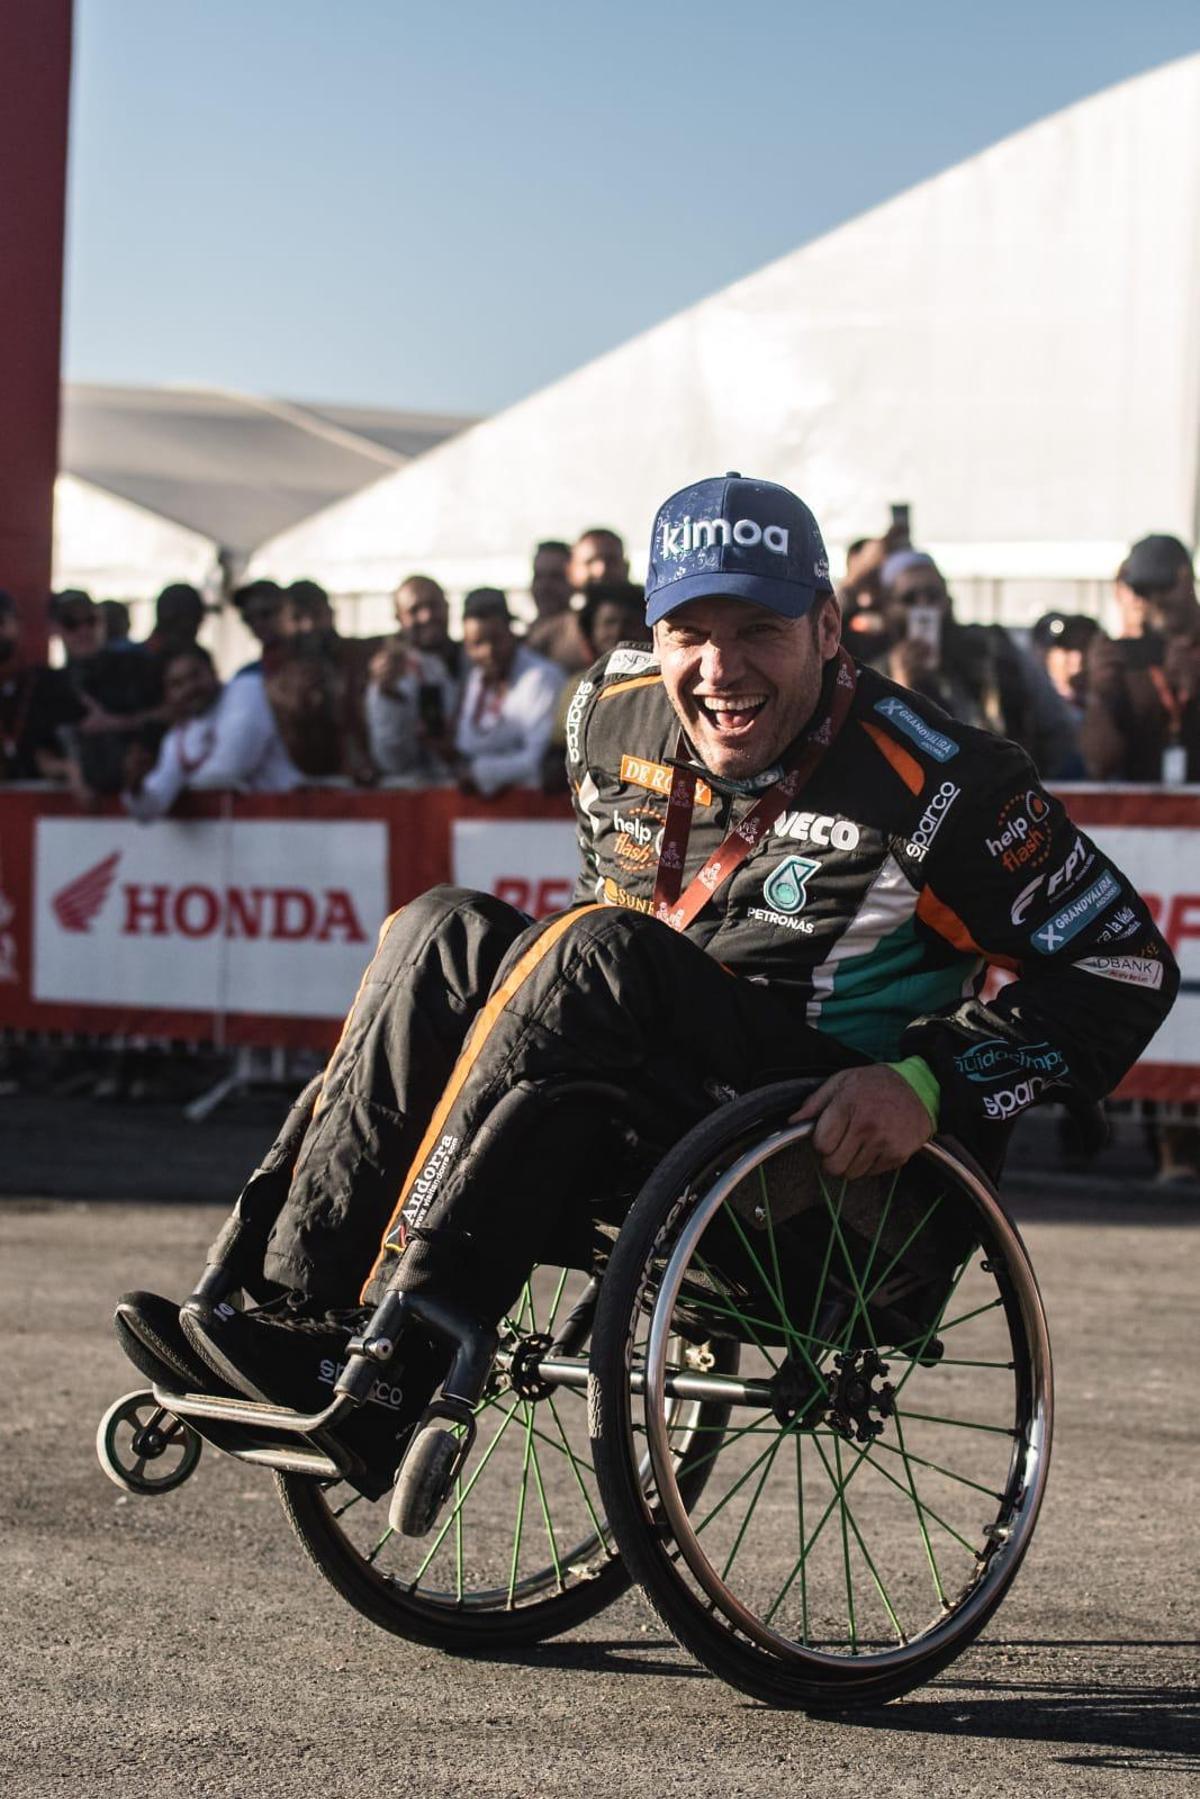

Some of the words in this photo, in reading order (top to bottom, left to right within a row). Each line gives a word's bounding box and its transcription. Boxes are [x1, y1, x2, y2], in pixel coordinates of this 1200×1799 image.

[662, 515, 789, 560] kimoa
[566, 680, 593, 763] sparco
[898, 709, 952, 754] GRANDVALIRA
[613, 809, 652, 846] help
[766, 810, 860, 851] VECO
[906, 781, 961, 862] sparco
[985, 817, 1028, 857] help
[614, 832, 653, 863] flash
[1002, 829, 1045, 871] flash
[122, 883, 367, 943] HONDA
[747, 906, 815, 934] PETRONAS
[1055, 875, 1112, 929] GRANDVALIRA
[982, 1077, 1043, 1120] spar
[401, 1135, 453, 1226] Andorra
